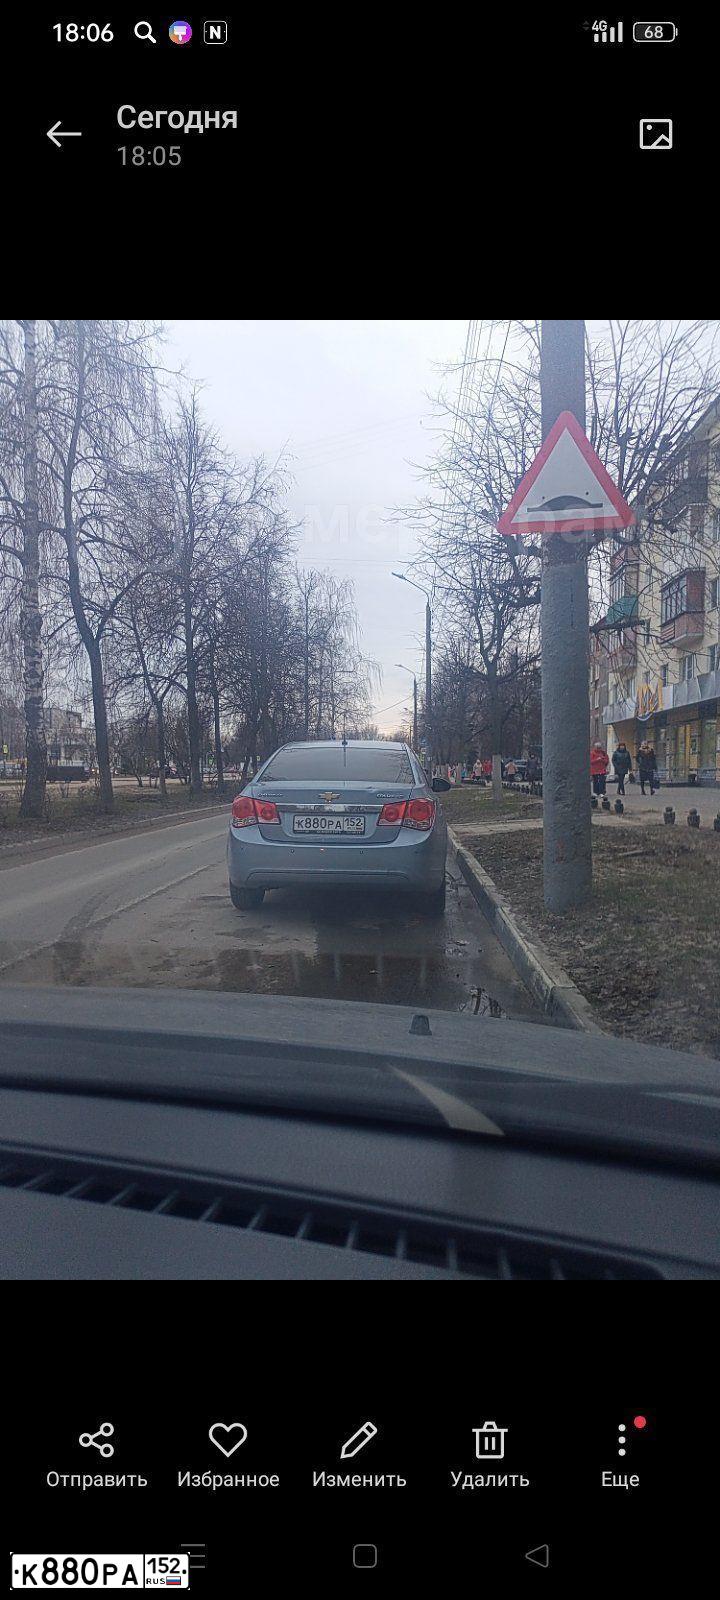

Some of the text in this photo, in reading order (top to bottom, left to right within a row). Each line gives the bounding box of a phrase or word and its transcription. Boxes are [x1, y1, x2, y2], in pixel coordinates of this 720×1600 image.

[53, 23, 114, 42] 18:06
[209, 25, 222, 40] N
[592, 20, 608, 32] 4G
[644, 25, 663, 39] 68
[116, 104, 238, 134] Сегодня
[117, 145, 182, 167] 18:05
[297, 817, 362, 829] К880РА 152
[46, 1470, 148, 1491] Отправить
[177, 1470, 280, 1491] Избранное
[312, 1471, 407, 1487] Изменить
[450, 1470, 530, 1490] Удалить
[601, 1470, 640, 1490] Еще
